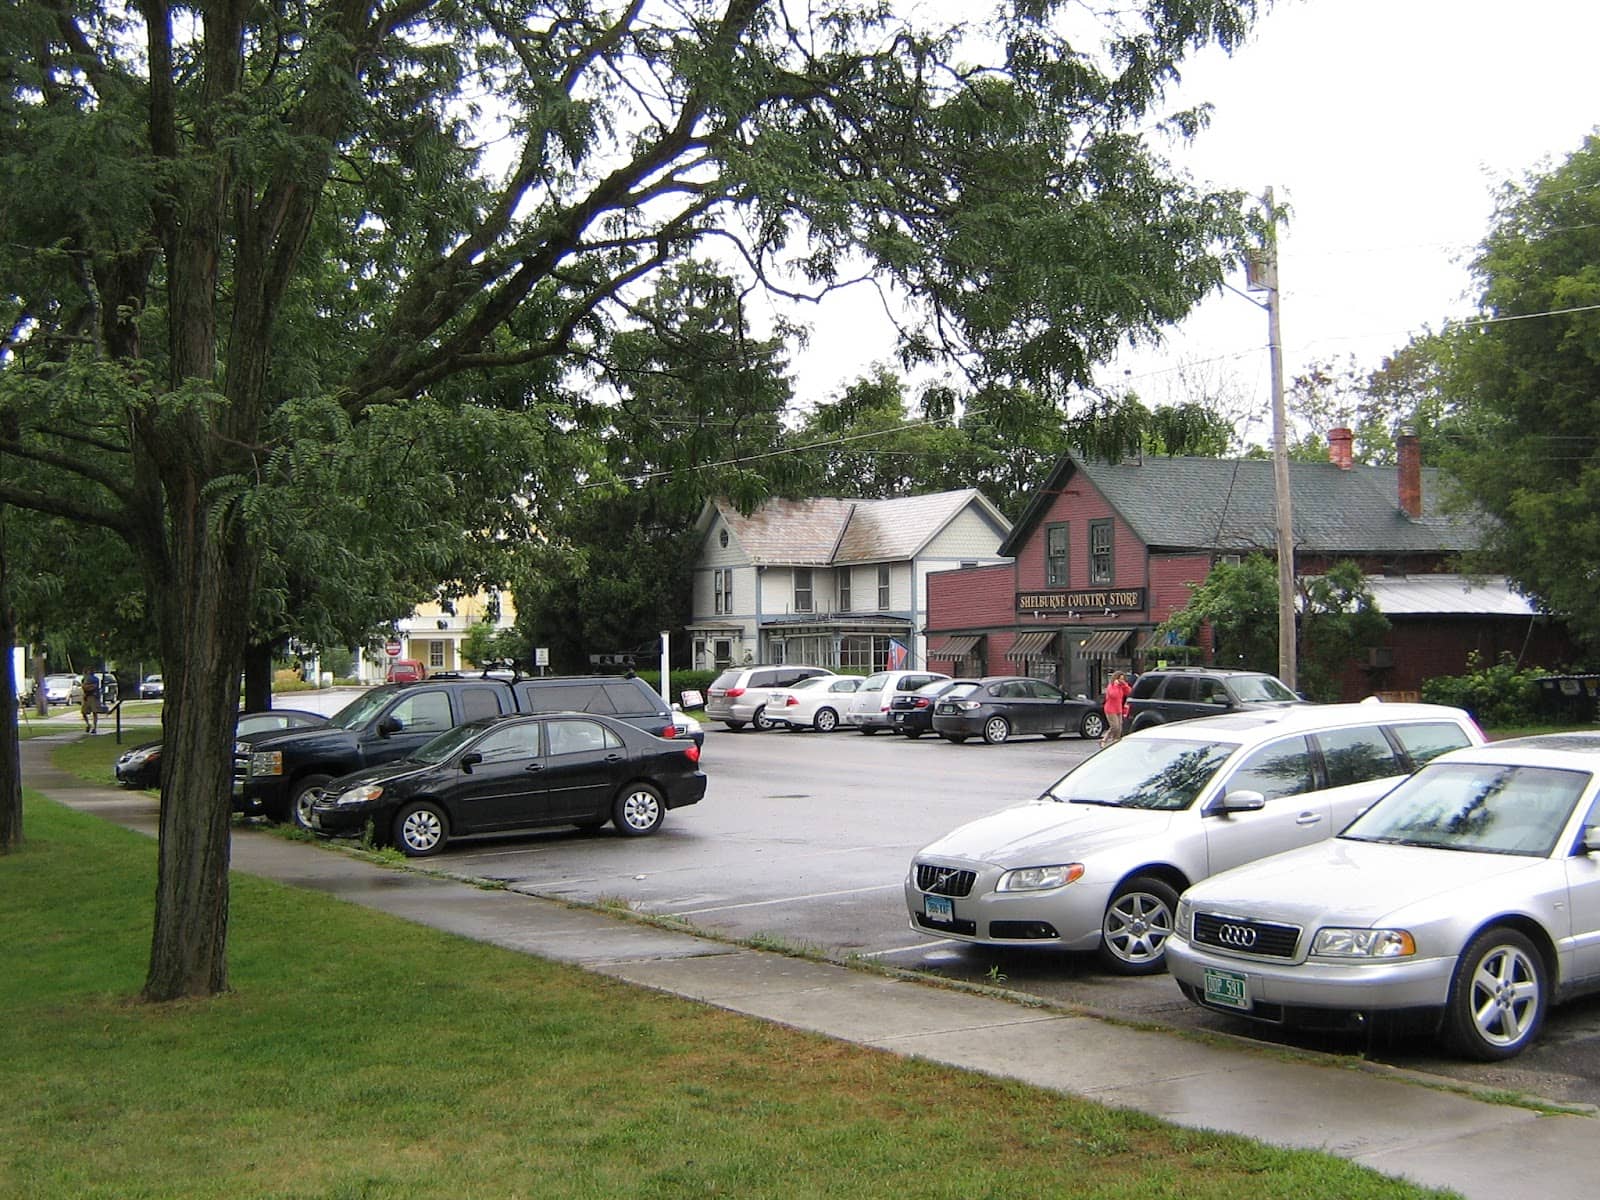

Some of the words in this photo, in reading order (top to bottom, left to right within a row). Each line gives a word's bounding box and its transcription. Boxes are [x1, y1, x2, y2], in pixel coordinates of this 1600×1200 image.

[1020, 595, 1066, 609] SHELBURNE
[1068, 593, 1107, 607] COUNTRY
[1110, 592, 1138, 606] STORE
